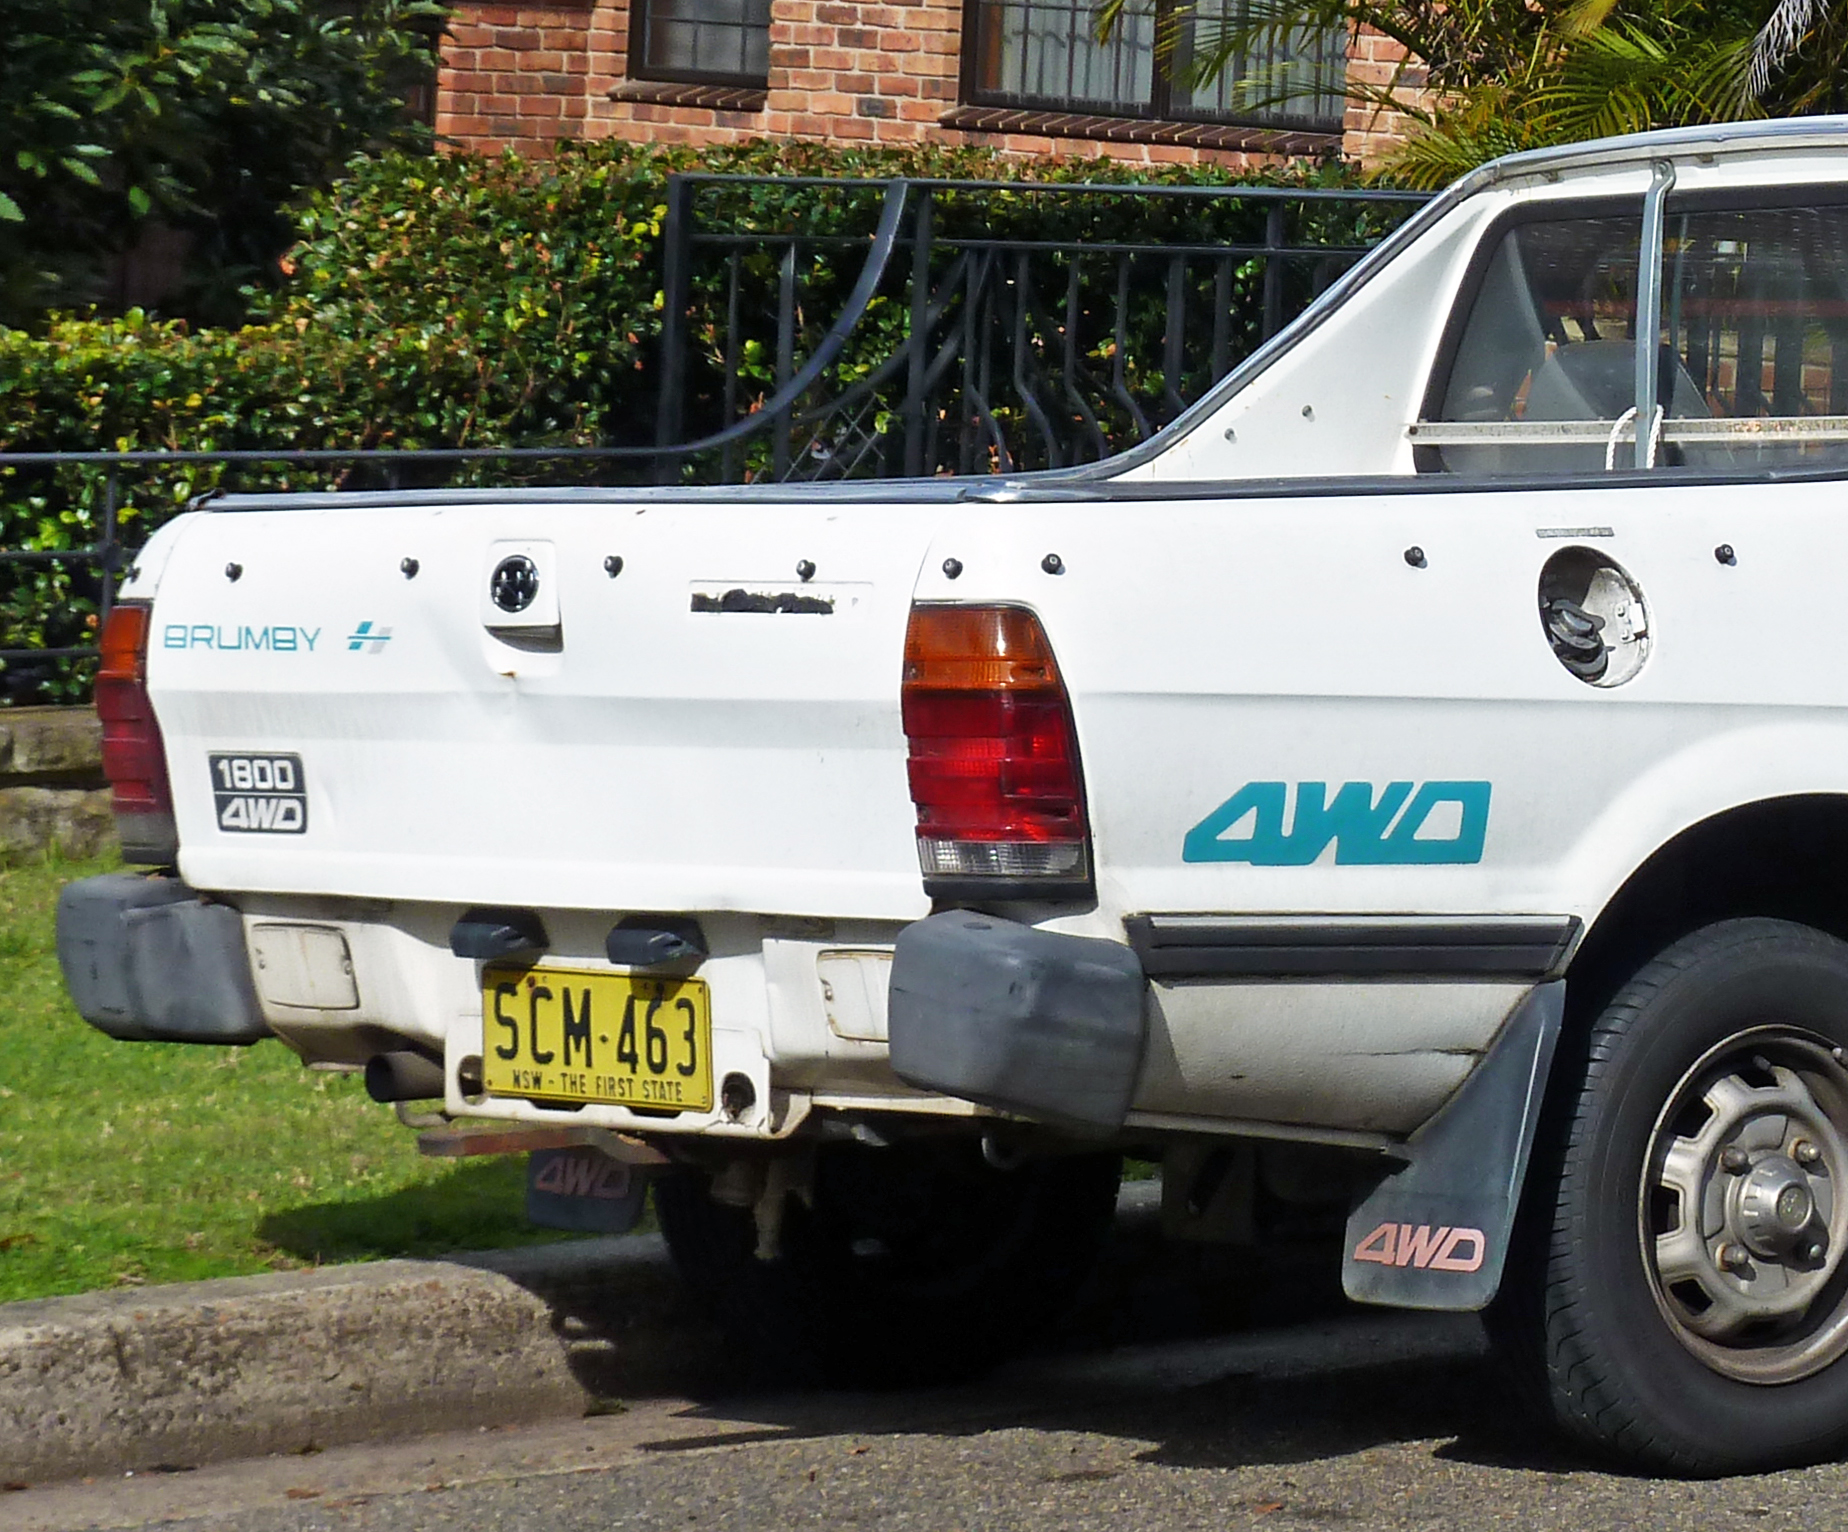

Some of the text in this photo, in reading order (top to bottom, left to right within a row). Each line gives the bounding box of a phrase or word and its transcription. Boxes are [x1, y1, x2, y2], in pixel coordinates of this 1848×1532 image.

[163, 624, 321, 651] BRUMBY
[217, 758, 295, 791] 1800
[220, 797, 303, 831] 4WD
[1182, 780, 1492, 867] 4WD
[512, 1068, 543, 1091] NSW
[559, 1072, 586, 1094] THE
[596, 1075, 635, 1098] FIRST
[642, 1080, 683, 1103] STATE
[534, 1156, 632, 1199] 4WD
[1352, 1222, 1485, 1273] 4WD
